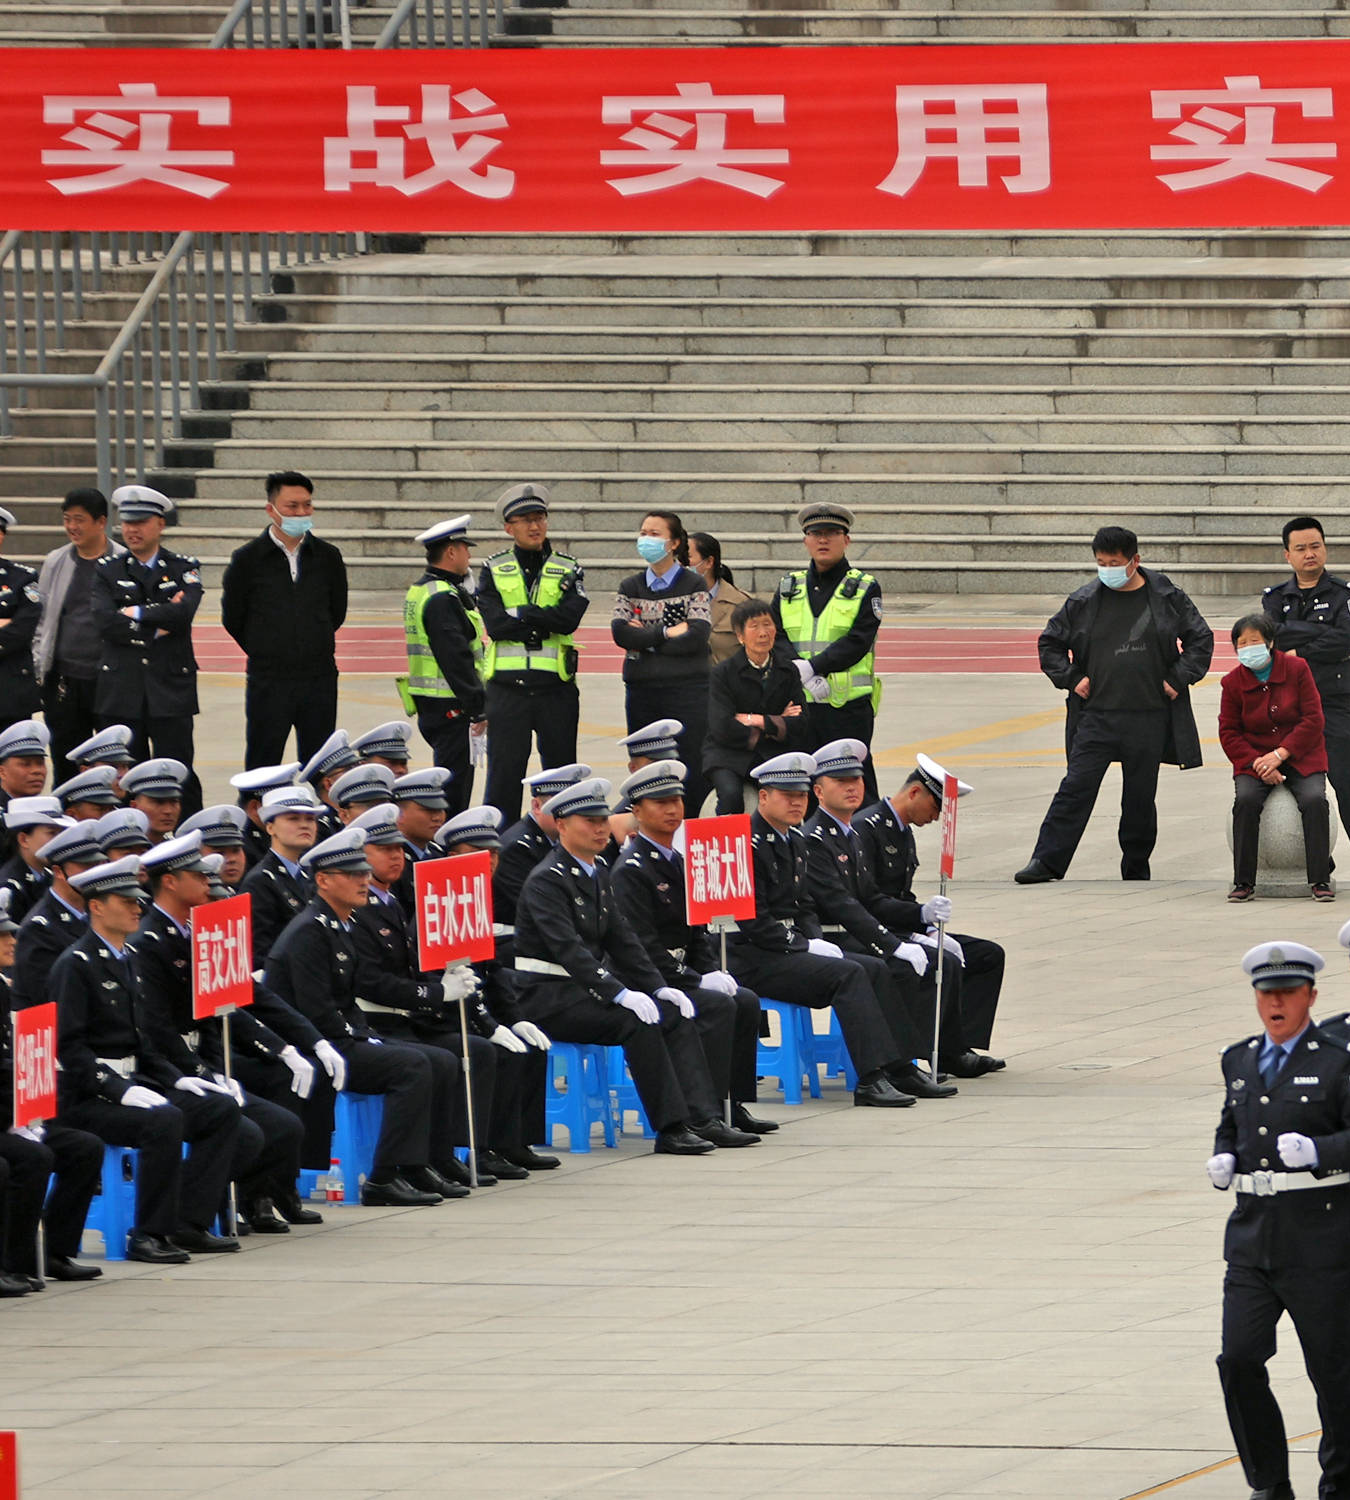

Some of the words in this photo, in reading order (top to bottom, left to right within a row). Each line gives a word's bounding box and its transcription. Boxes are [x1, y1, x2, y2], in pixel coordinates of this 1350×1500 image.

[689, 834, 752, 903] 蒲城大队
[424, 872, 491, 947] 白水大队
[197, 915, 251, 996] 高交大队
